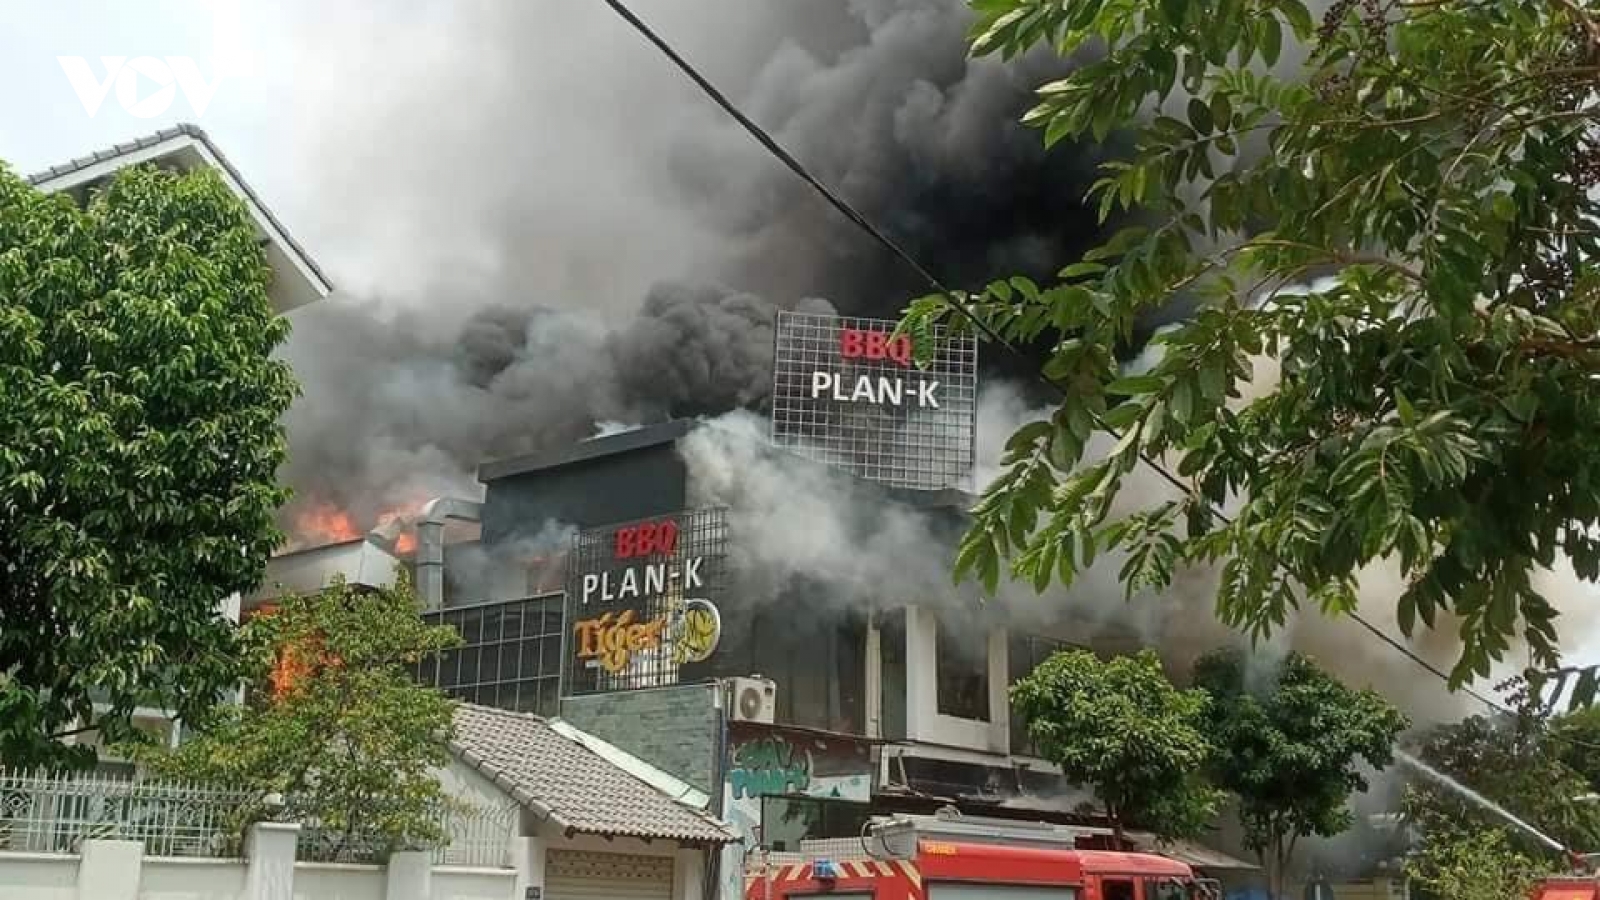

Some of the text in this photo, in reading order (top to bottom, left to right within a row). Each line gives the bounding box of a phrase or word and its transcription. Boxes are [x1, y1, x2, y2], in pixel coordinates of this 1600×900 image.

[840, 327, 912, 366] BBQ
[811, 371, 940, 409] PLAN-K
[614, 519, 678, 559] BBQ
[582, 556, 703, 604] PLAN-K
[573, 609, 667, 675] Tiger
